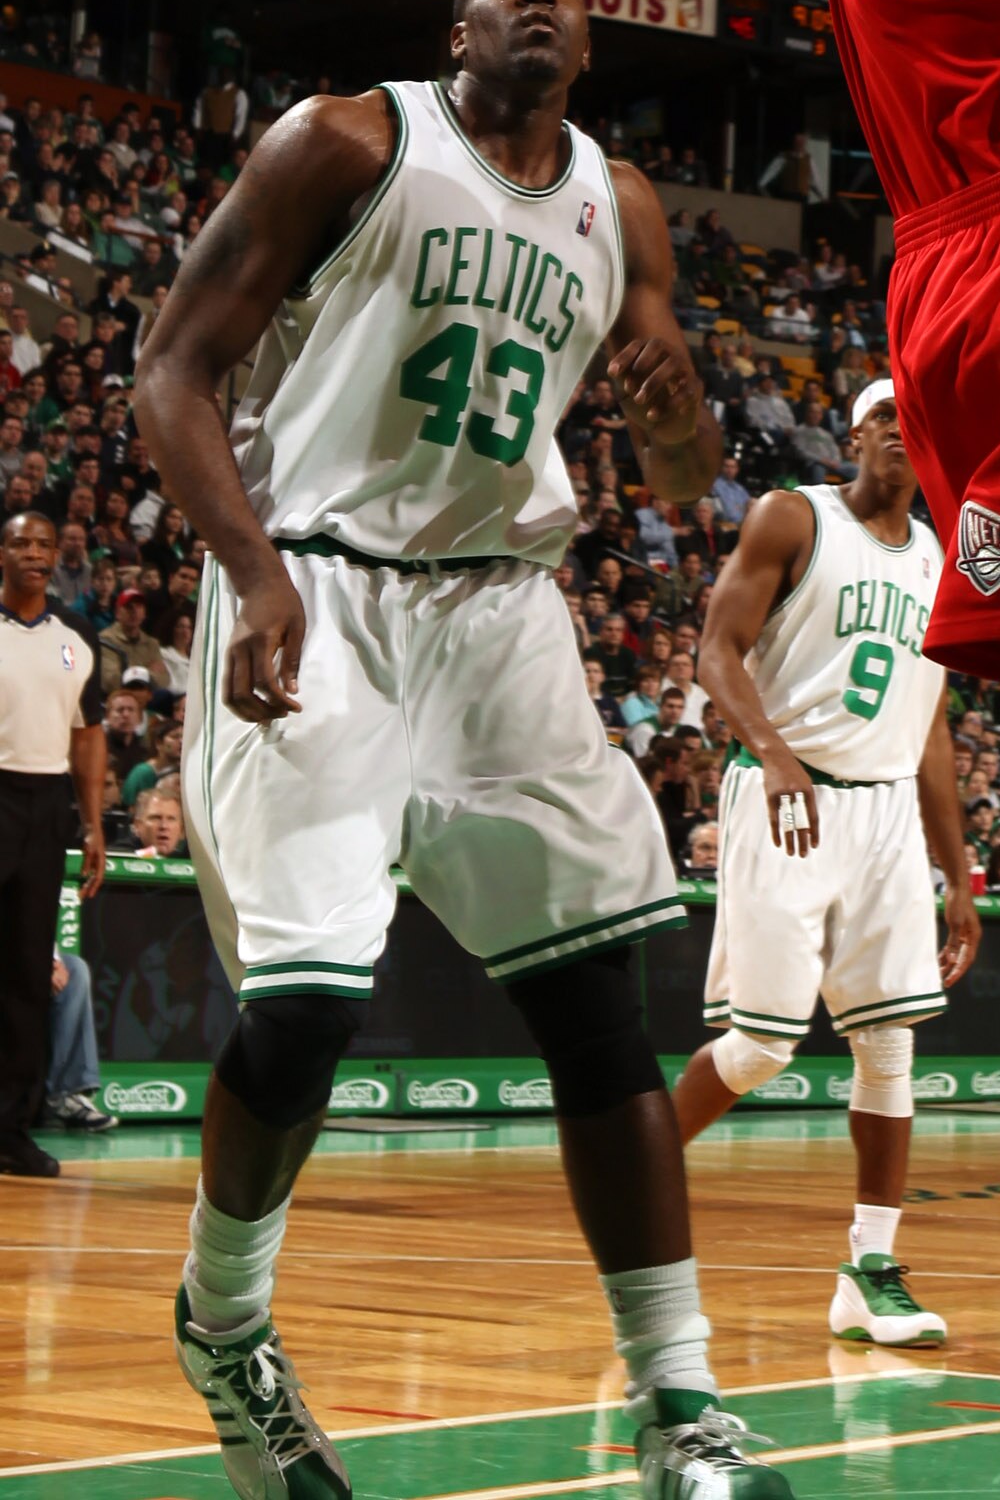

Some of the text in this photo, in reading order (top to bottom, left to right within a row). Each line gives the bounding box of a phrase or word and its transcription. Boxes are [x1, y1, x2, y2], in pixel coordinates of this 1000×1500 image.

[411, 227, 583, 353] CELTICS
[400, 322, 545, 468] 43
[835, 579, 929, 658] CELTICS
[842, 640, 894, 722] 9
